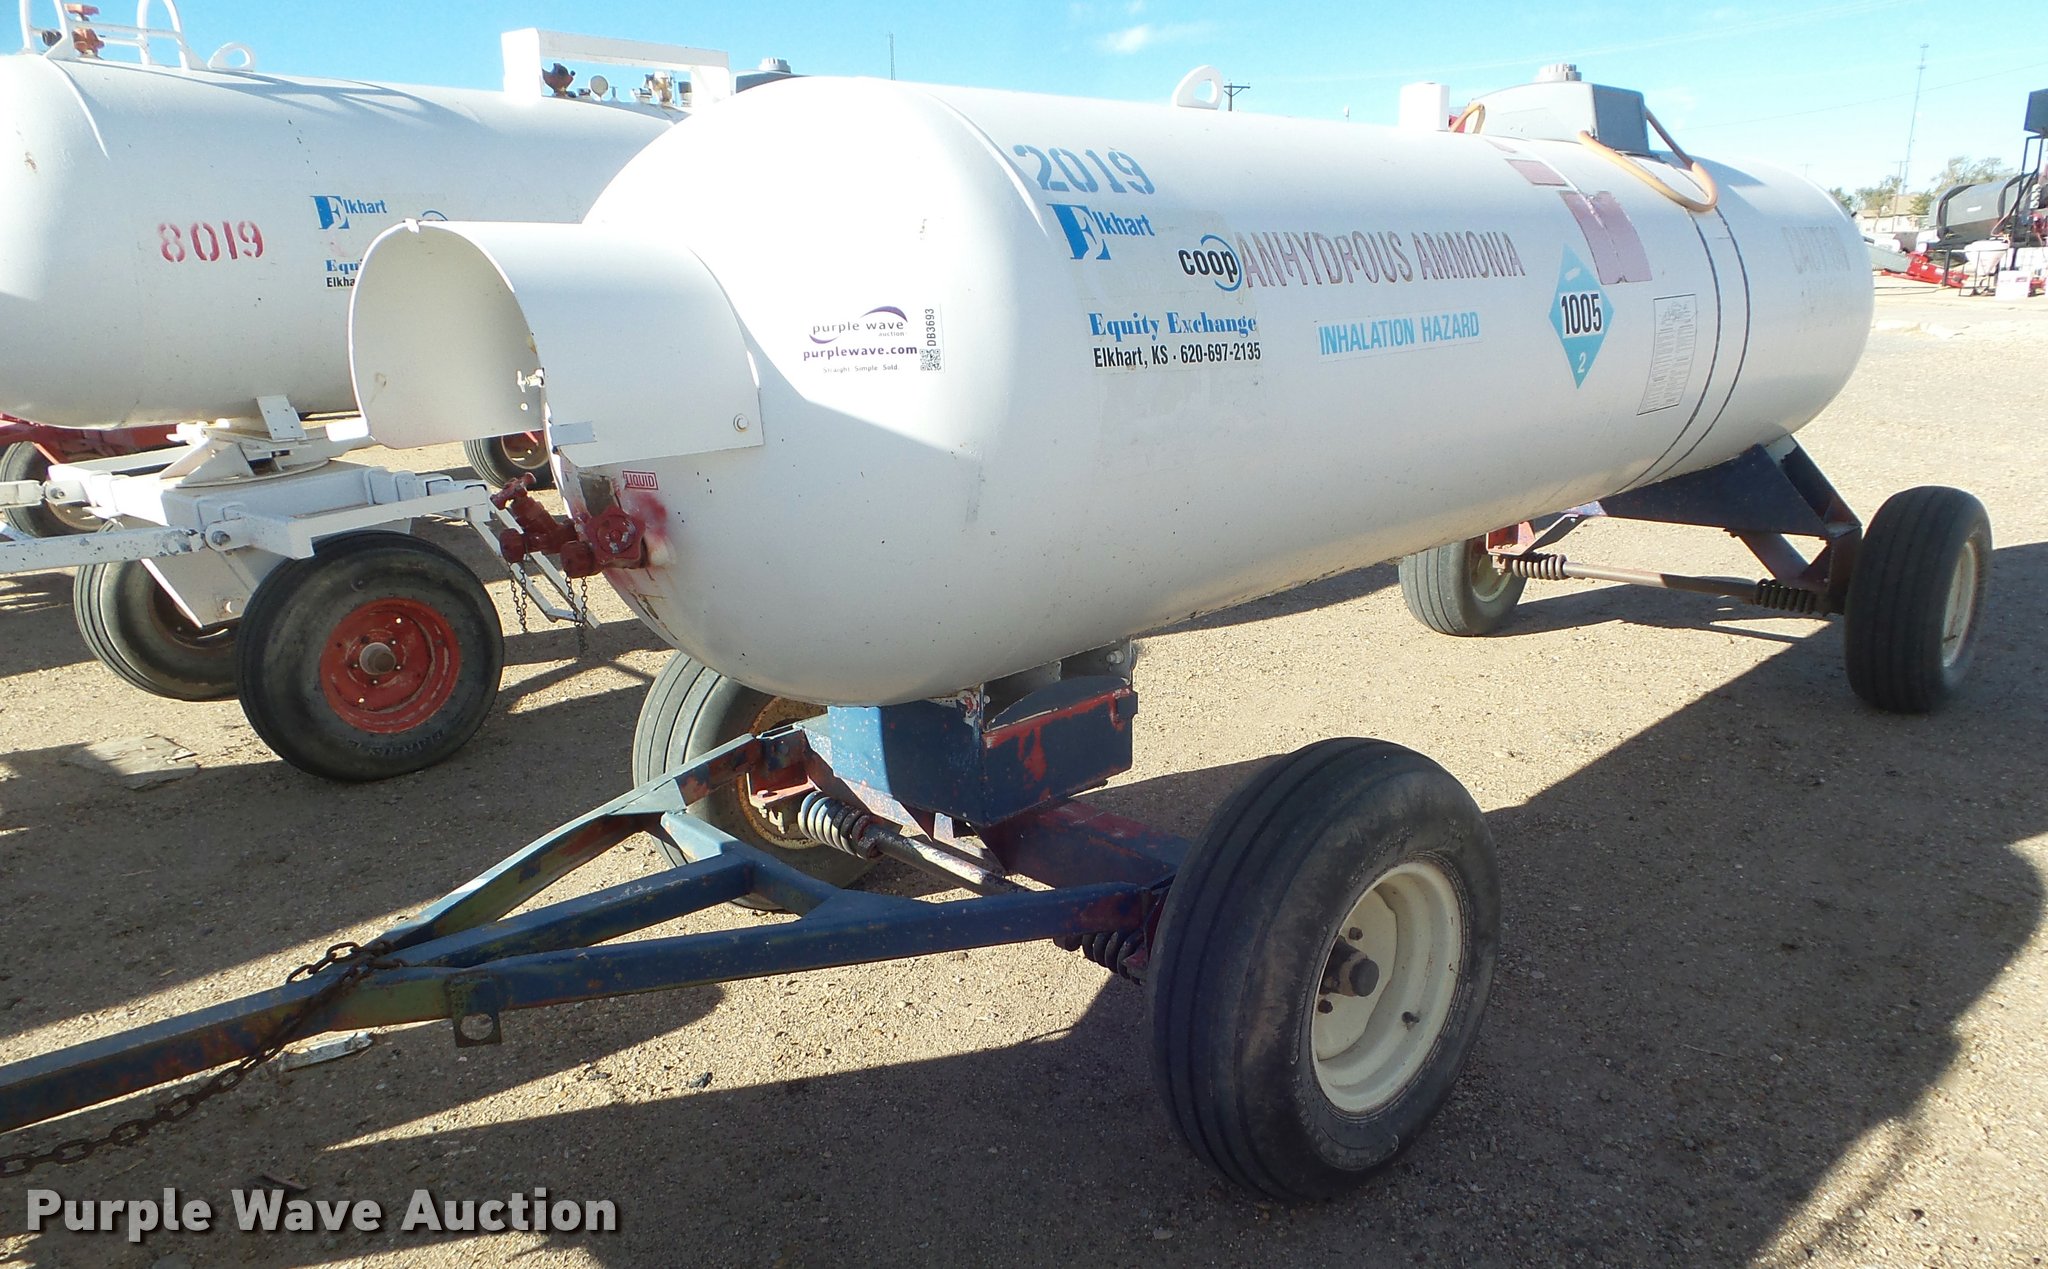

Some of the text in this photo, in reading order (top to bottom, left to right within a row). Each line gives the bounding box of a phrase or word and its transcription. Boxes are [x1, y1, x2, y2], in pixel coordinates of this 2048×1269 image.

[1013, 144, 1156, 195] 2019
[310, 195, 388, 230] Elkhart
[157, 219, 265, 263] 8019
[1046, 202, 1156, 261] Elkhart
[1411, 230, 1526, 280] AMMONIA
[812, 320, 905, 335] purple wave
[924, 307, 937, 347] DB3693
[1087, 310, 1259, 343] Equity Exchange
[1560, 292, 1602, 336] 1005
[1318, 311, 1480, 356] INHALATION HAZARD
[803, 345, 918, 362] purplewave.com
[1093, 347, 1149, 369] Elkhart,
[1151, 345, 1169, 366] KS
[1180, 341, 1262, 364] 620-697-2135
[1577, 351, 1587, 375] 2
[624, 473, 655, 487] LIQUID
